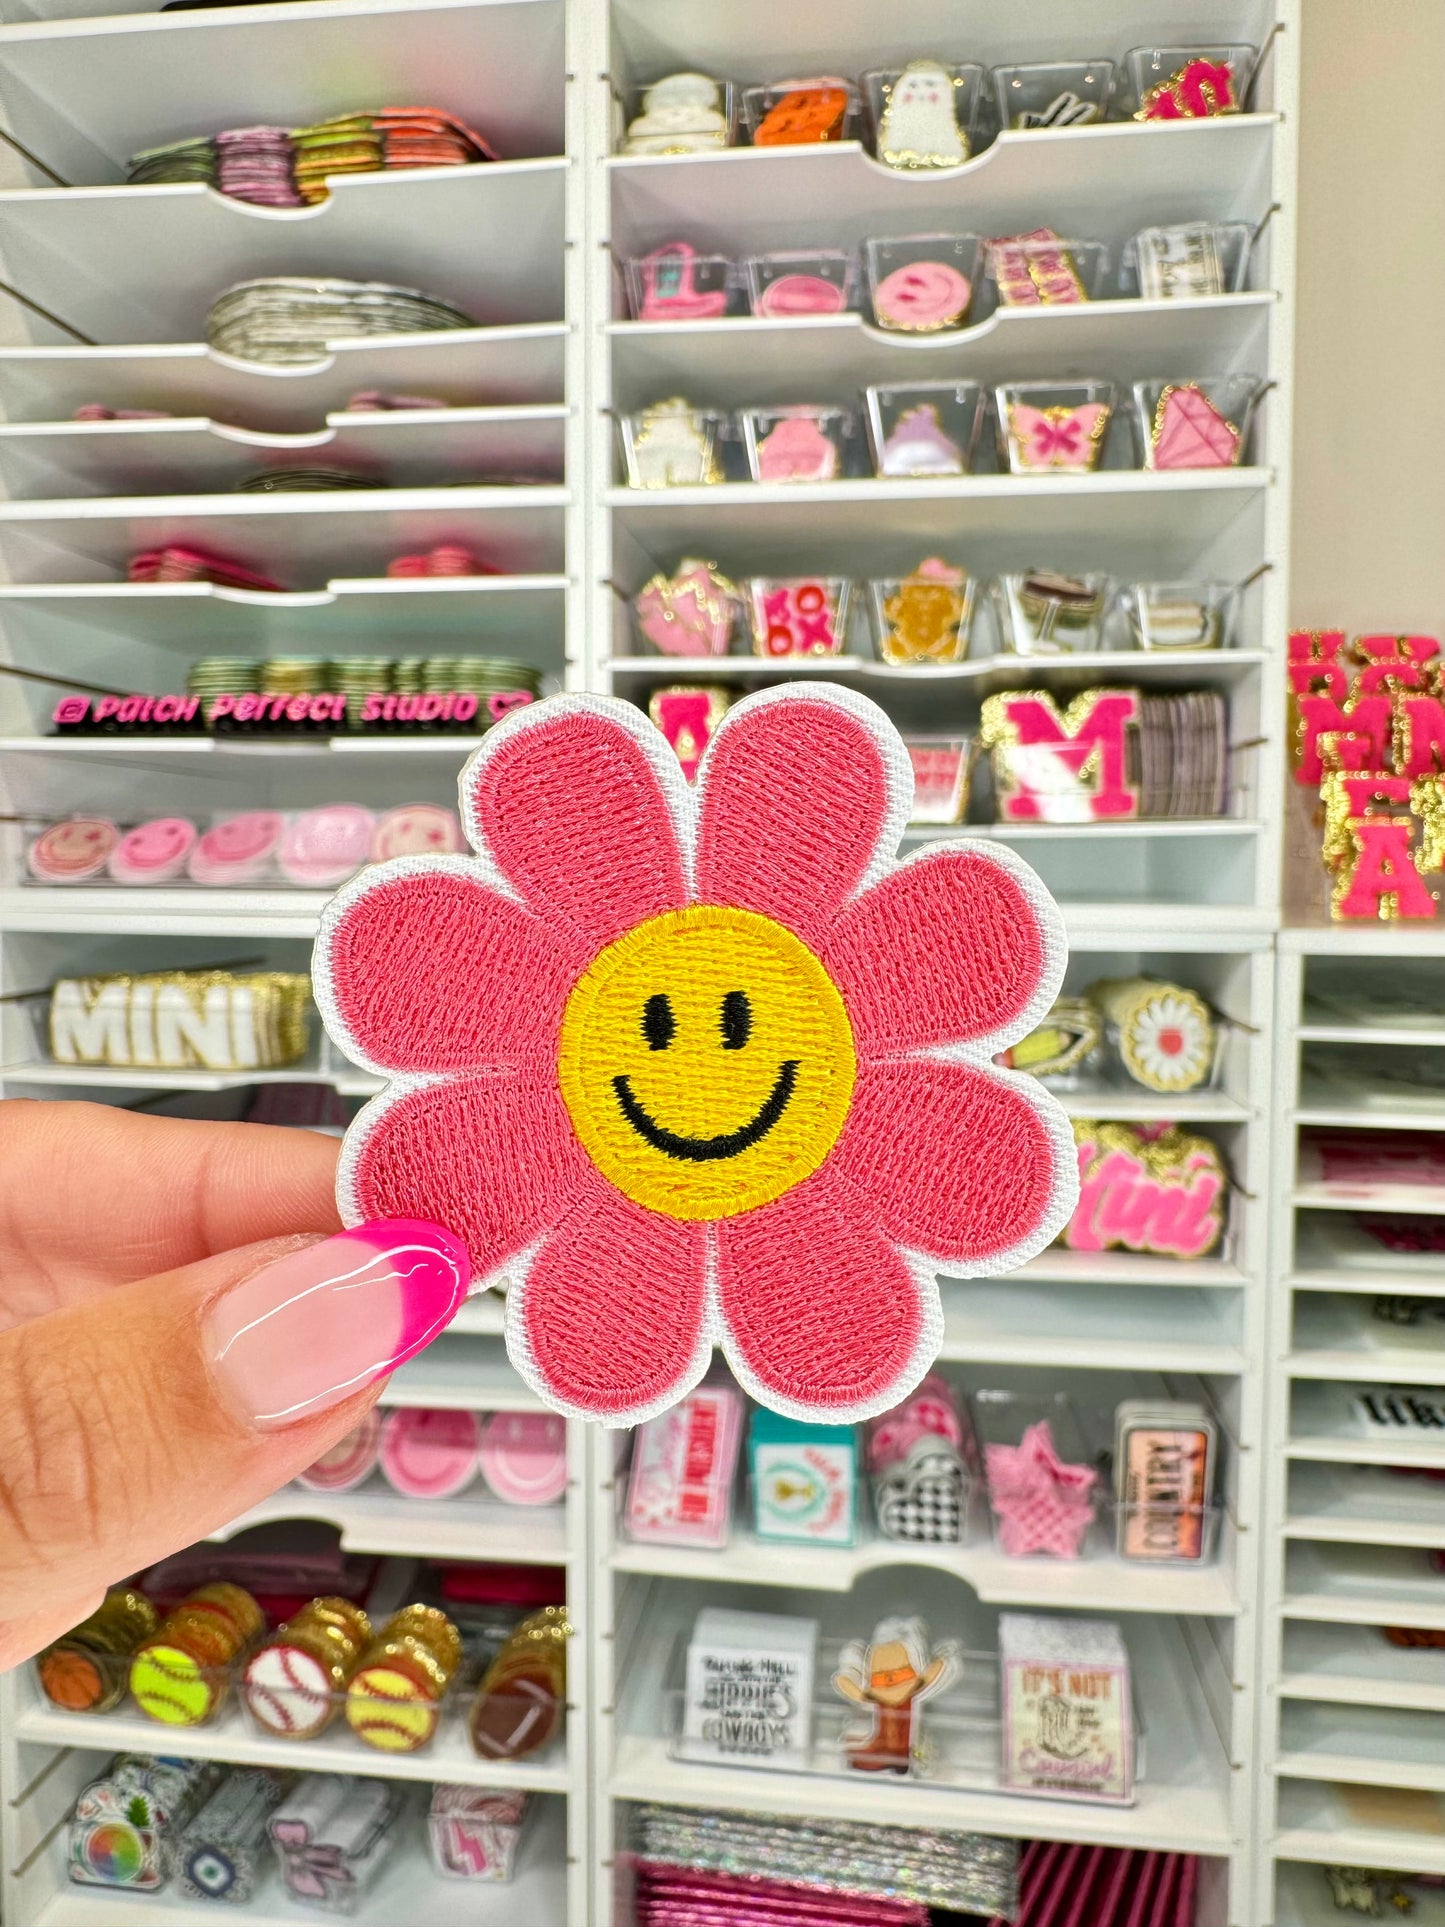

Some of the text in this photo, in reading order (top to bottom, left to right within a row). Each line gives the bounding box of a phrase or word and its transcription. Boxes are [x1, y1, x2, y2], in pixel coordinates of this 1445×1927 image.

[1003, 692, 1139, 820] M
[1340, 822, 1436, 919] A
[53, 979, 258, 1068] MINI
